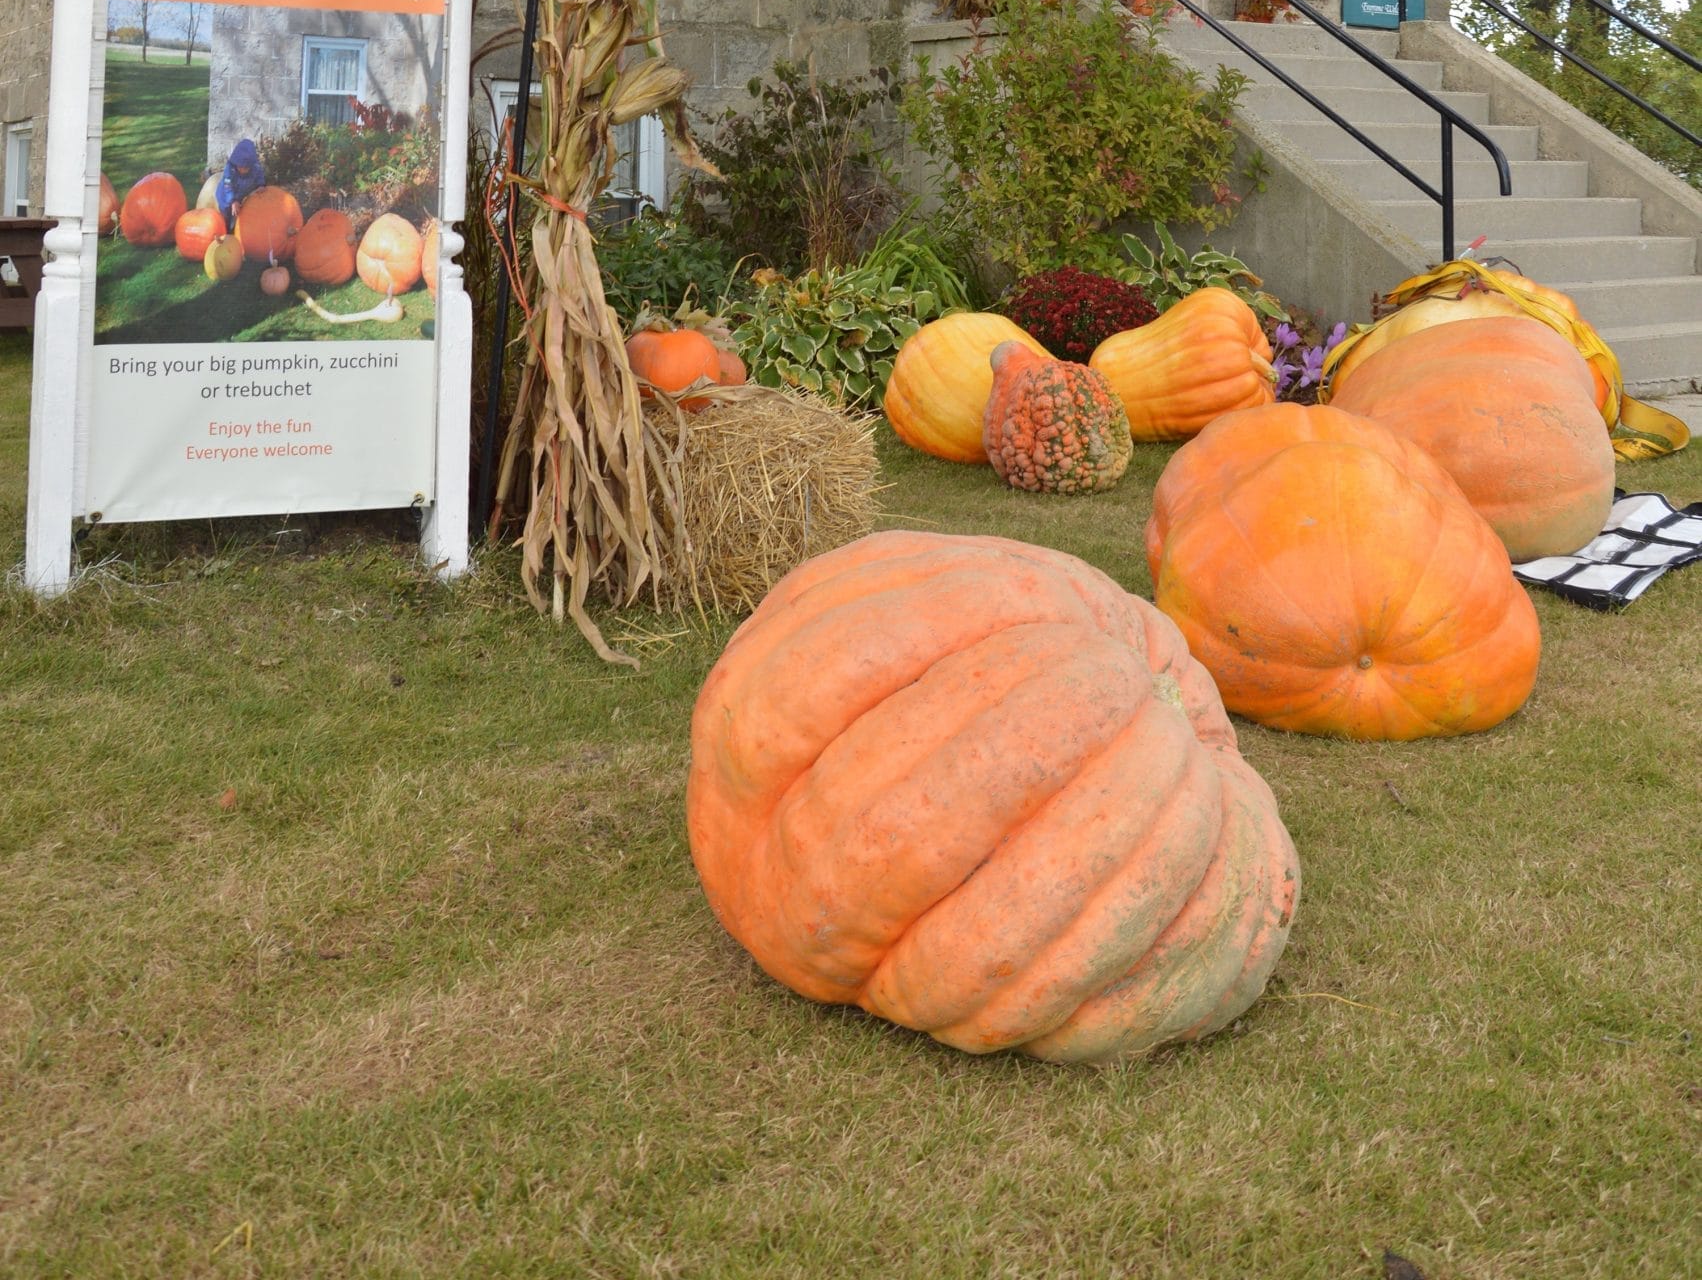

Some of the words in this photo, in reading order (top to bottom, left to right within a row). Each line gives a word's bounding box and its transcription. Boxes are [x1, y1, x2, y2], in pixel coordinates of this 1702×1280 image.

[109, 356, 157, 377] Bring
[163, 359, 204, 376] your
[210, 355, 236, 375] big
[242, 354, 325, 375] pumpkin,
[329, 352, 399, 370] zucchini
[200, 384, 220, 399] or
[225, 380, 312, 398] trebuchet
[209, 421, 252, 437] Enjoy
[256, 419, 282, 435] the
[286, 418, 312, 434] fun
[186, 444, 259, 462] Everyone
[264, 442, 333, 458] welcome
